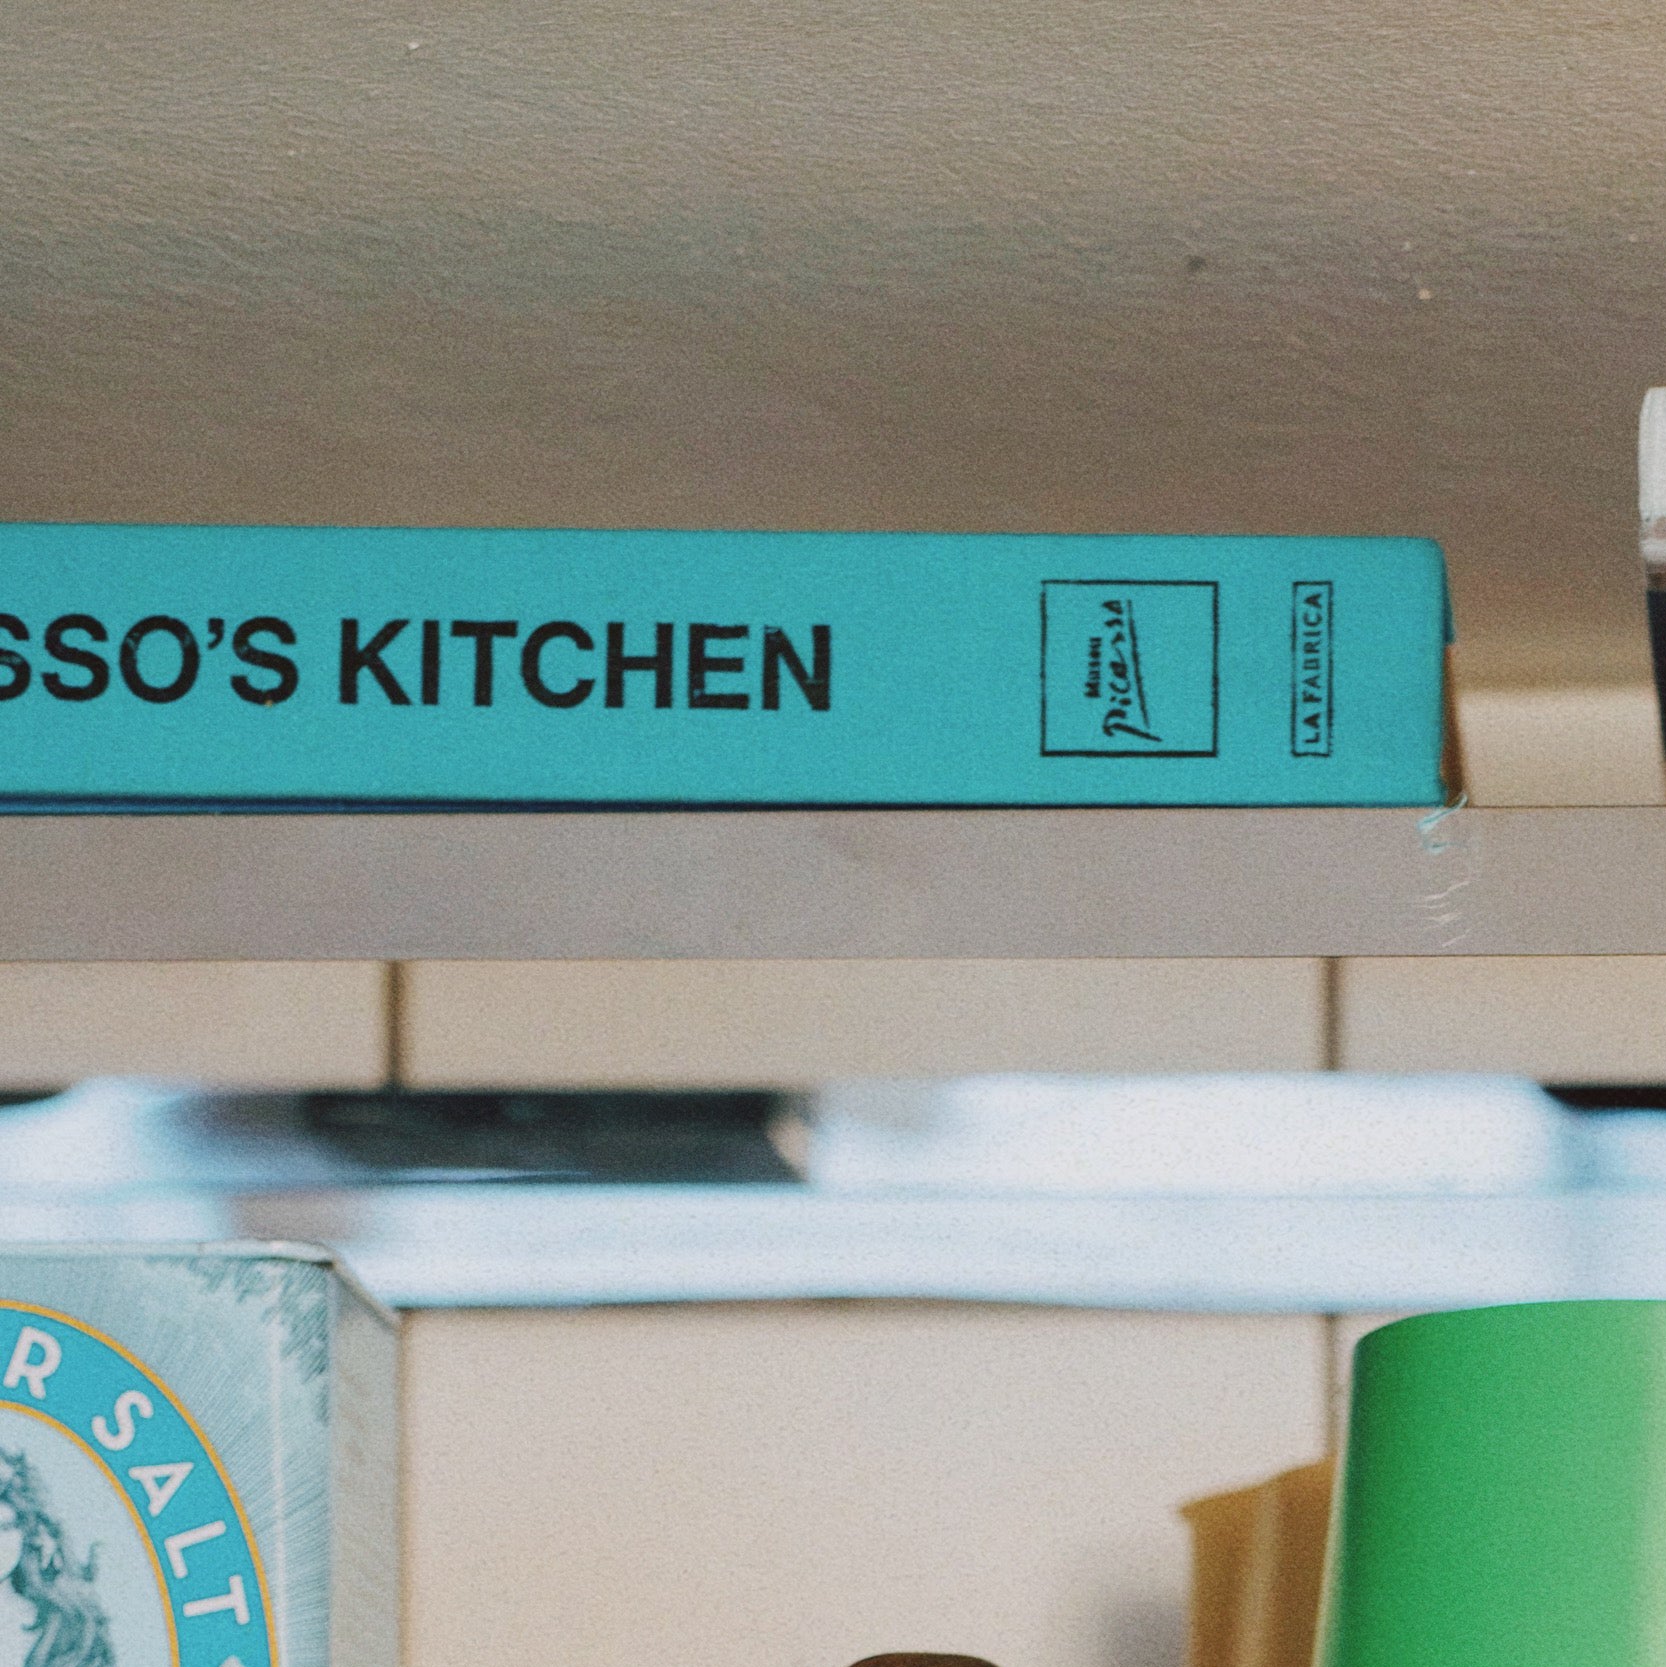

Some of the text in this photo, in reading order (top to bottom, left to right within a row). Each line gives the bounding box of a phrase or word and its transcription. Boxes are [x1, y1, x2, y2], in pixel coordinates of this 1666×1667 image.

[338, 617, 832, 711] KITCHEN
[1302, 592, 1323, 744] LA FABRICA
[92, 1390, 250, 1634] SALT
